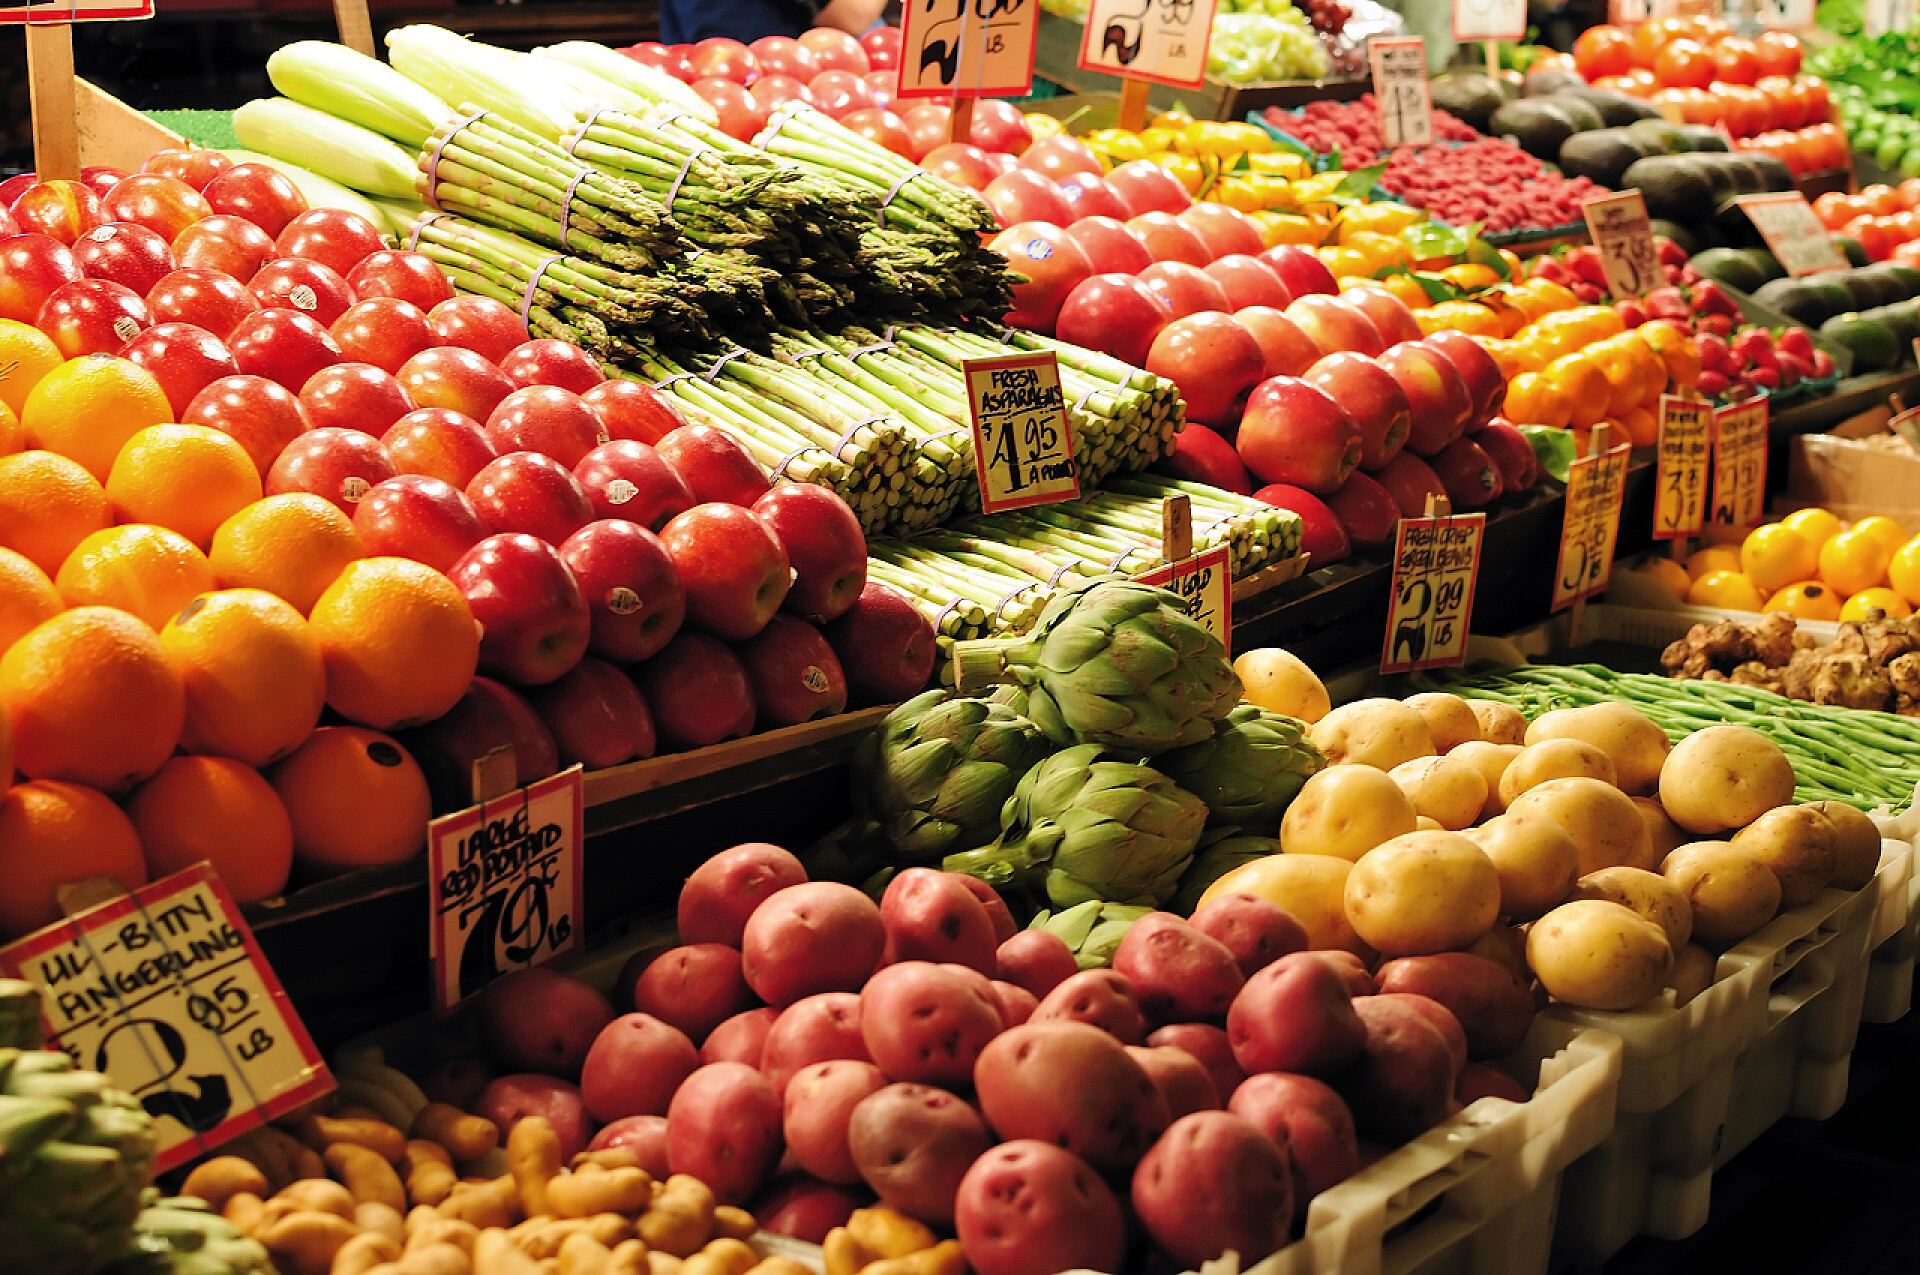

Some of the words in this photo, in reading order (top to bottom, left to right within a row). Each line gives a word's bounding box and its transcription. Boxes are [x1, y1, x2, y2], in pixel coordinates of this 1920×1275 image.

[985, 34, 1005, 54] LB
[991, 369, 1038, 389] FRESH
[982, 385, 1064, 413] ASPARAGUS
[1029, 464, 1040, 484] A
[1404, 527, 1438, 547] FRESH
[1440, 526, 1474, 546] CRISP
[1400, 549, 1435, 568] GREEN
[1437, 546, 1472, 567] BEANS
[1434, 622, 1453, 647] LB
[458, 804, 530, 867] LARGE
[440, 863, 480, 900] RED
[485, 823, 562, 883] POTATO
[549, 914, 571, 951] LB
[57, 923, 245, 1021] FINGERLING
[237, 1027, 274, 1060] LB
